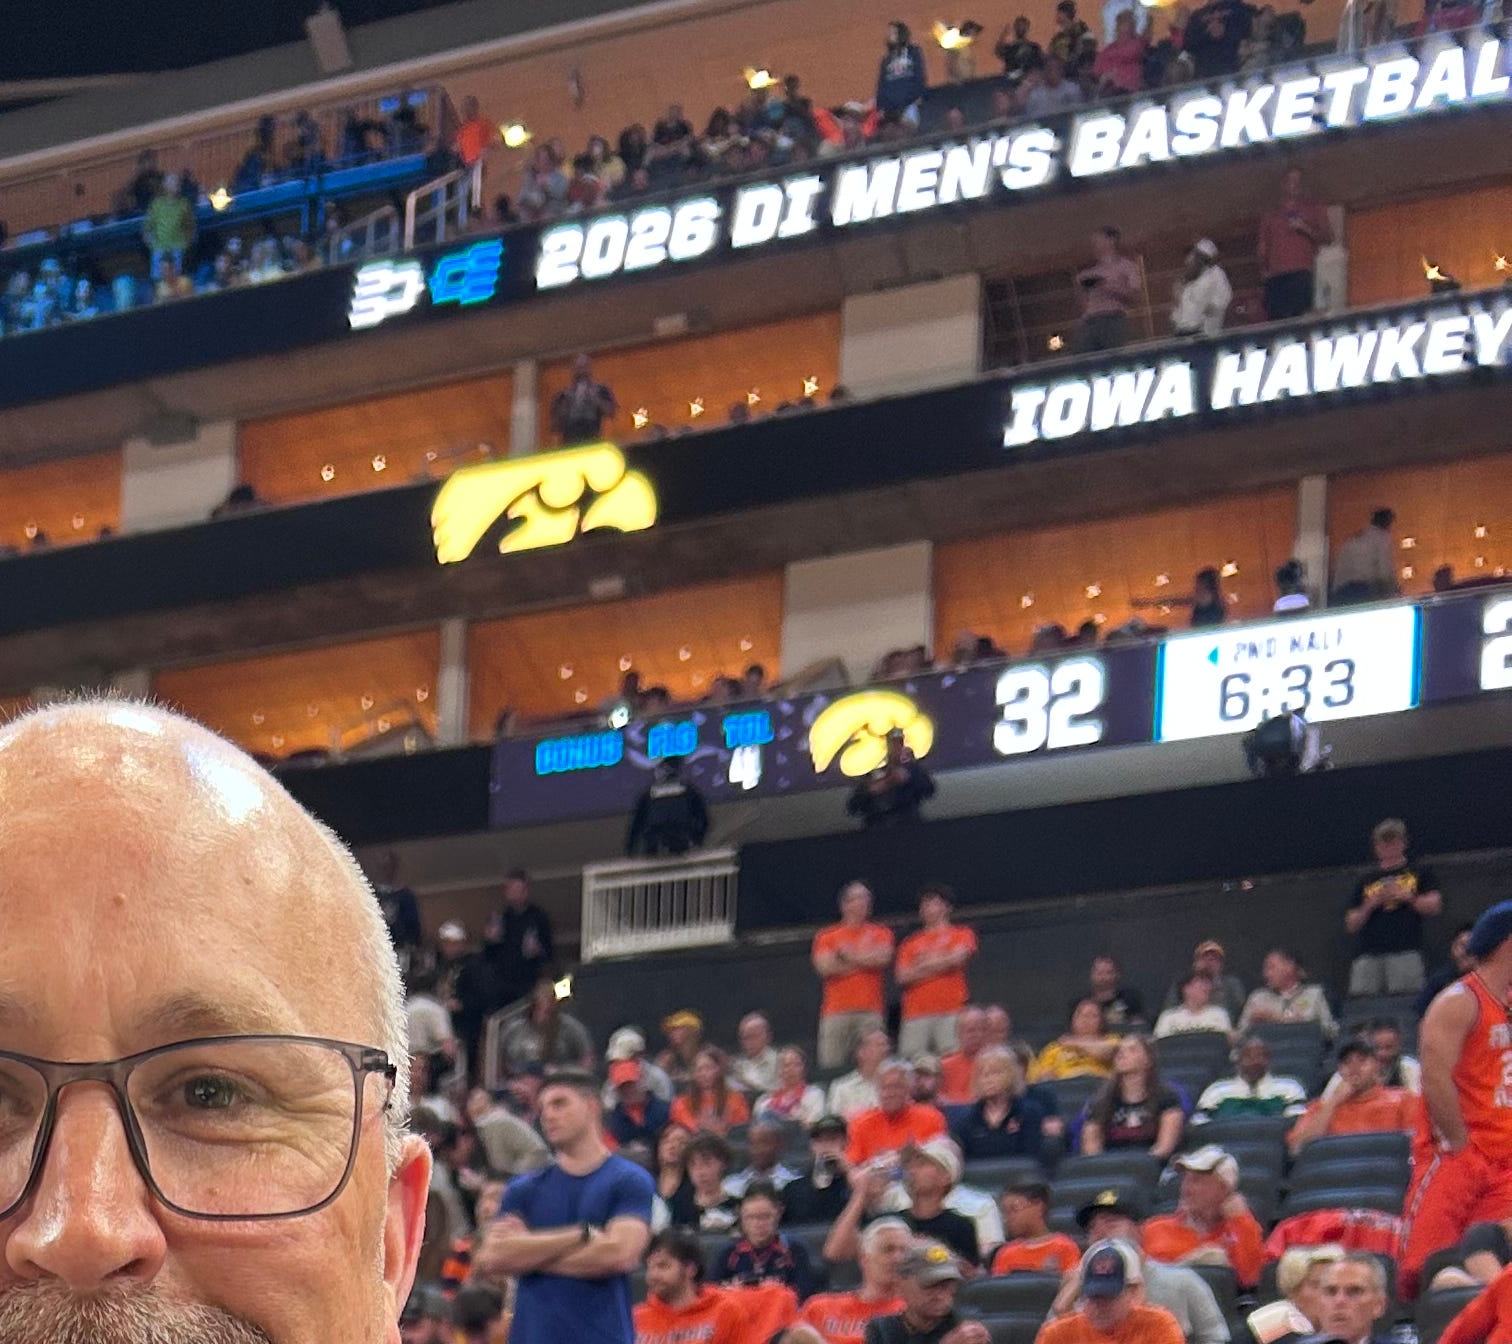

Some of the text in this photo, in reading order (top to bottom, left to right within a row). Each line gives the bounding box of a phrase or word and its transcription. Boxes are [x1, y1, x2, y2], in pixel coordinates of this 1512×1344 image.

[535, 37, 1512, 290] 2026 DI MEN'S BASKETBAL
[1003, 306, 1512, 448] IOWA HAWKEY
[993, 655, 1105, 757] 32
[1218, 657, 1356, 722] 6:33
